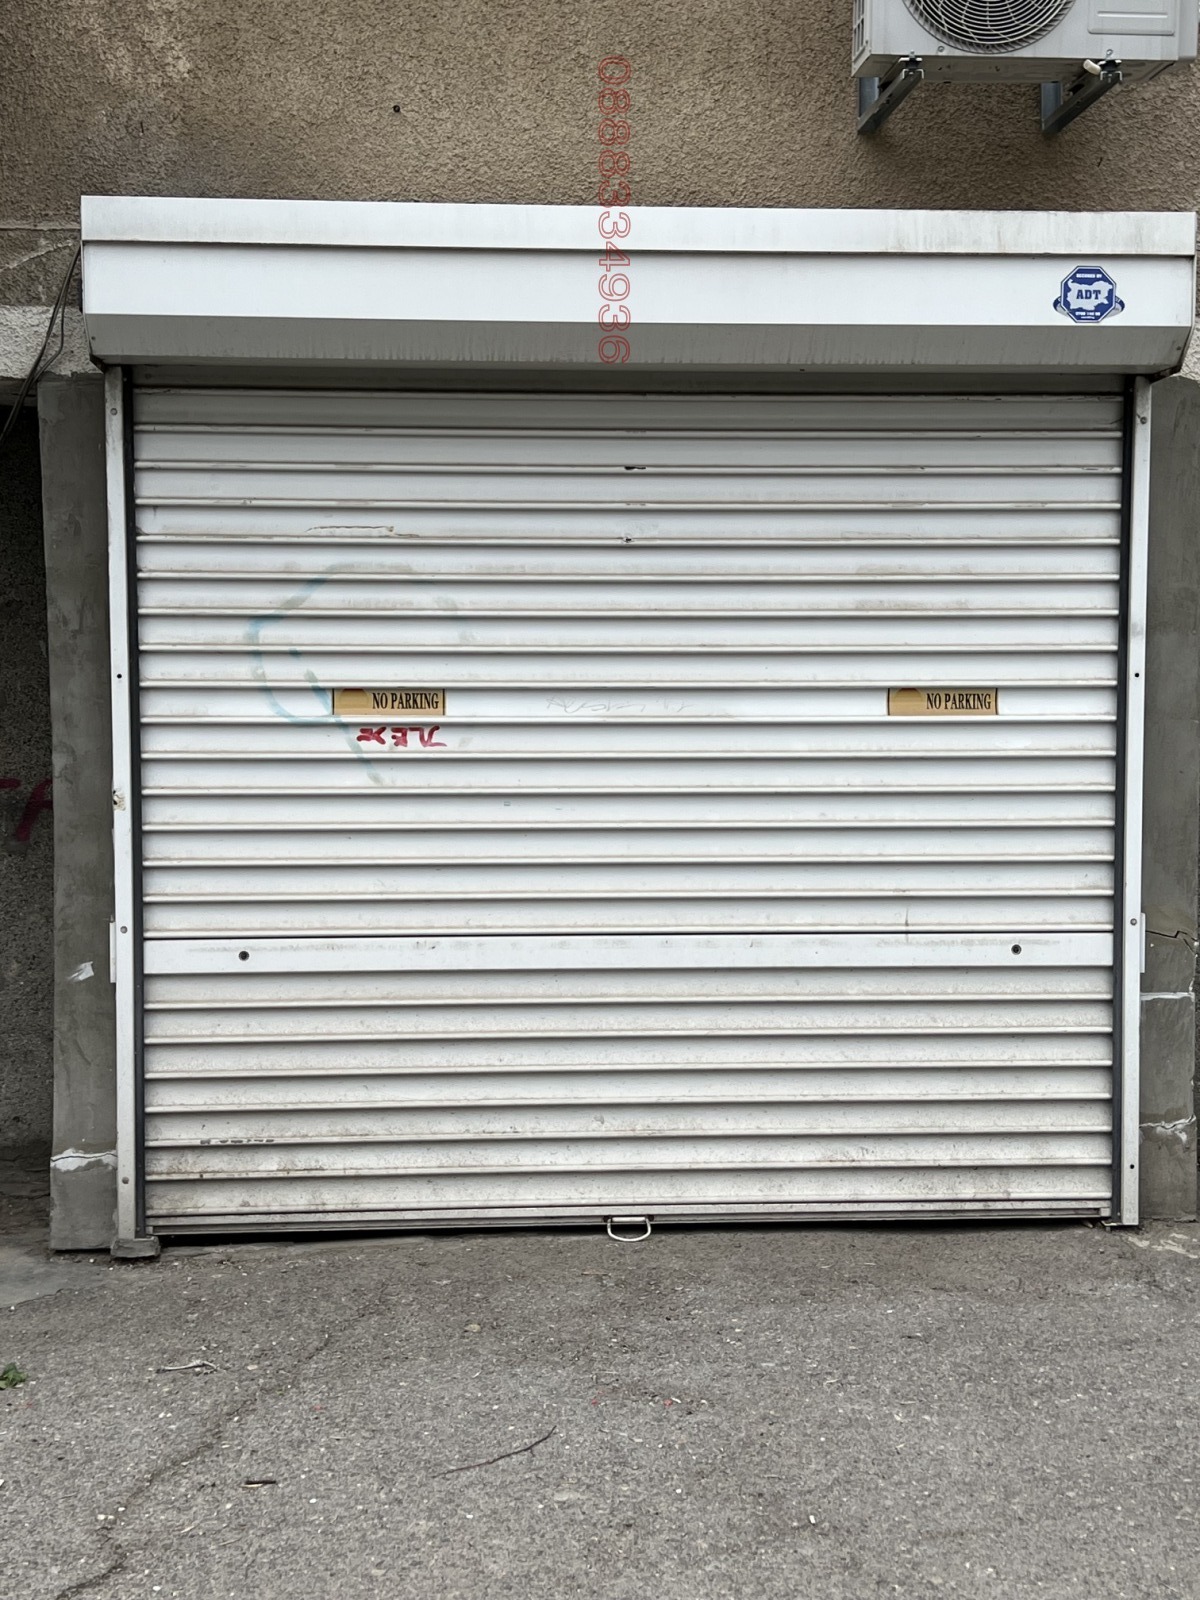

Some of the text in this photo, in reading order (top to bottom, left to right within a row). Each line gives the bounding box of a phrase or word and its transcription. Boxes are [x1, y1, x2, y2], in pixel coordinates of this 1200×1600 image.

[1076, 289, 1101, 300] ADT
[372, 692, 439, 710] NO PARKING
[926, 693, 992, 710] NO PARKING
